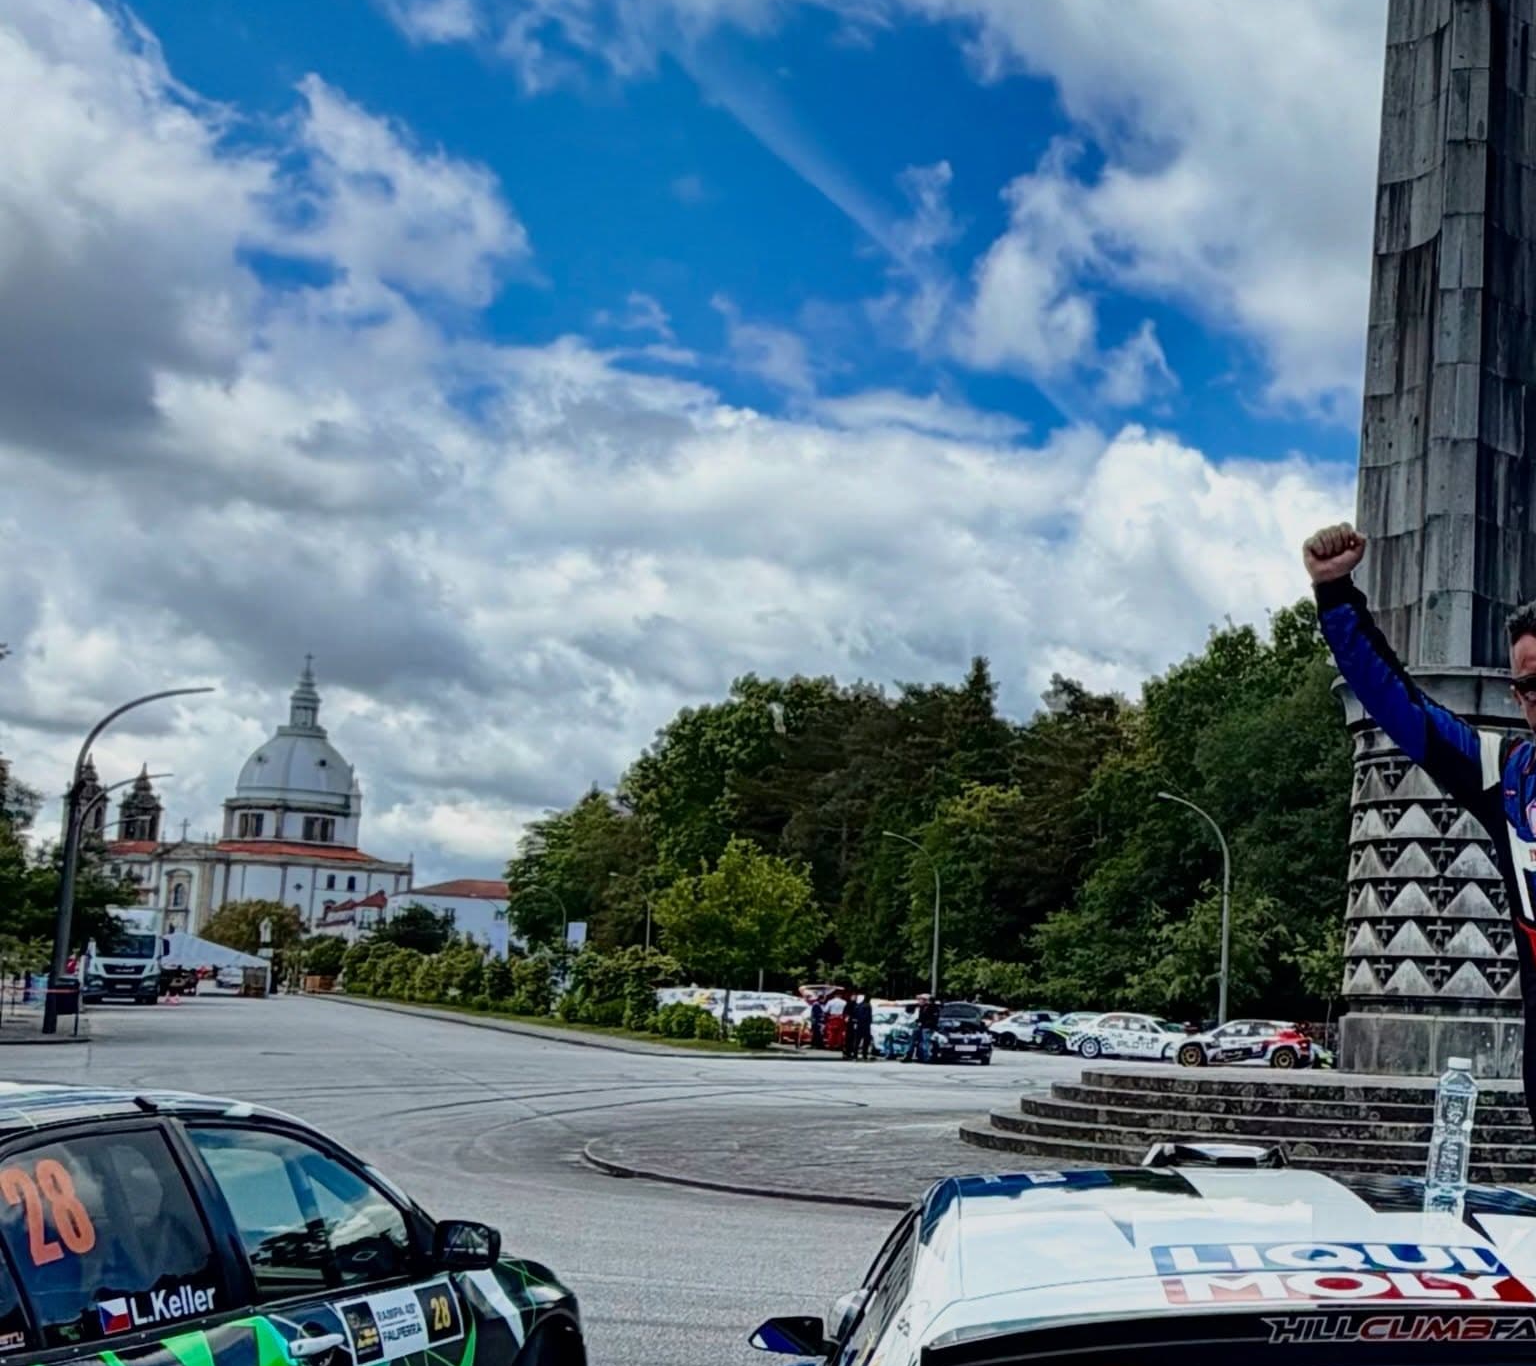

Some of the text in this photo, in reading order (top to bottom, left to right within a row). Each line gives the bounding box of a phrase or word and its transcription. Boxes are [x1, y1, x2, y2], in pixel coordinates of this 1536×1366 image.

[0, 1159, 97, 1267] 28
[1166, 1243, 1501, 1270] LIQUI
[130, 1285, 215, 1325] L.Keller
[1170, 1272, 1518, 1302] MOLY
[430, 1295, 452, 1331] 28
